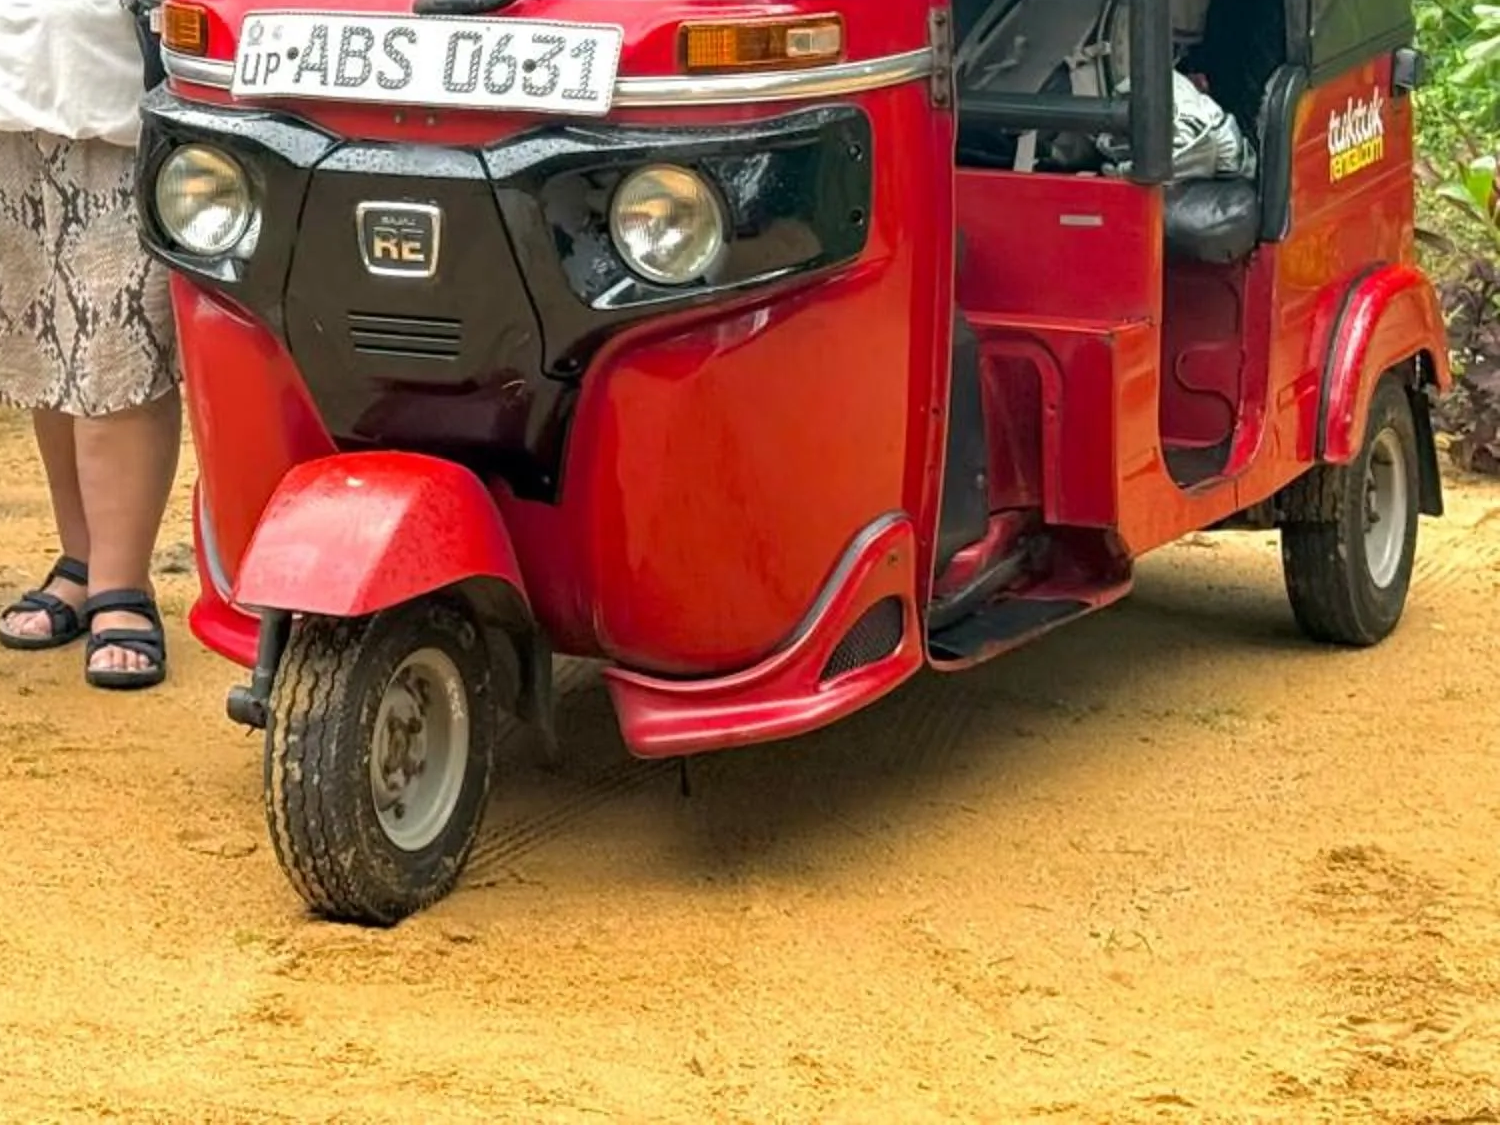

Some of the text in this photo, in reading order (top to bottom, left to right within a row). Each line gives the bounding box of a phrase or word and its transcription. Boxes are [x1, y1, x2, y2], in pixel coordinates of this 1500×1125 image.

[241, 23, 598, 101] UP ABS 0631
[1328, 86, 1385, 155] tuktuk
[373, 226, 425, 262] RE
